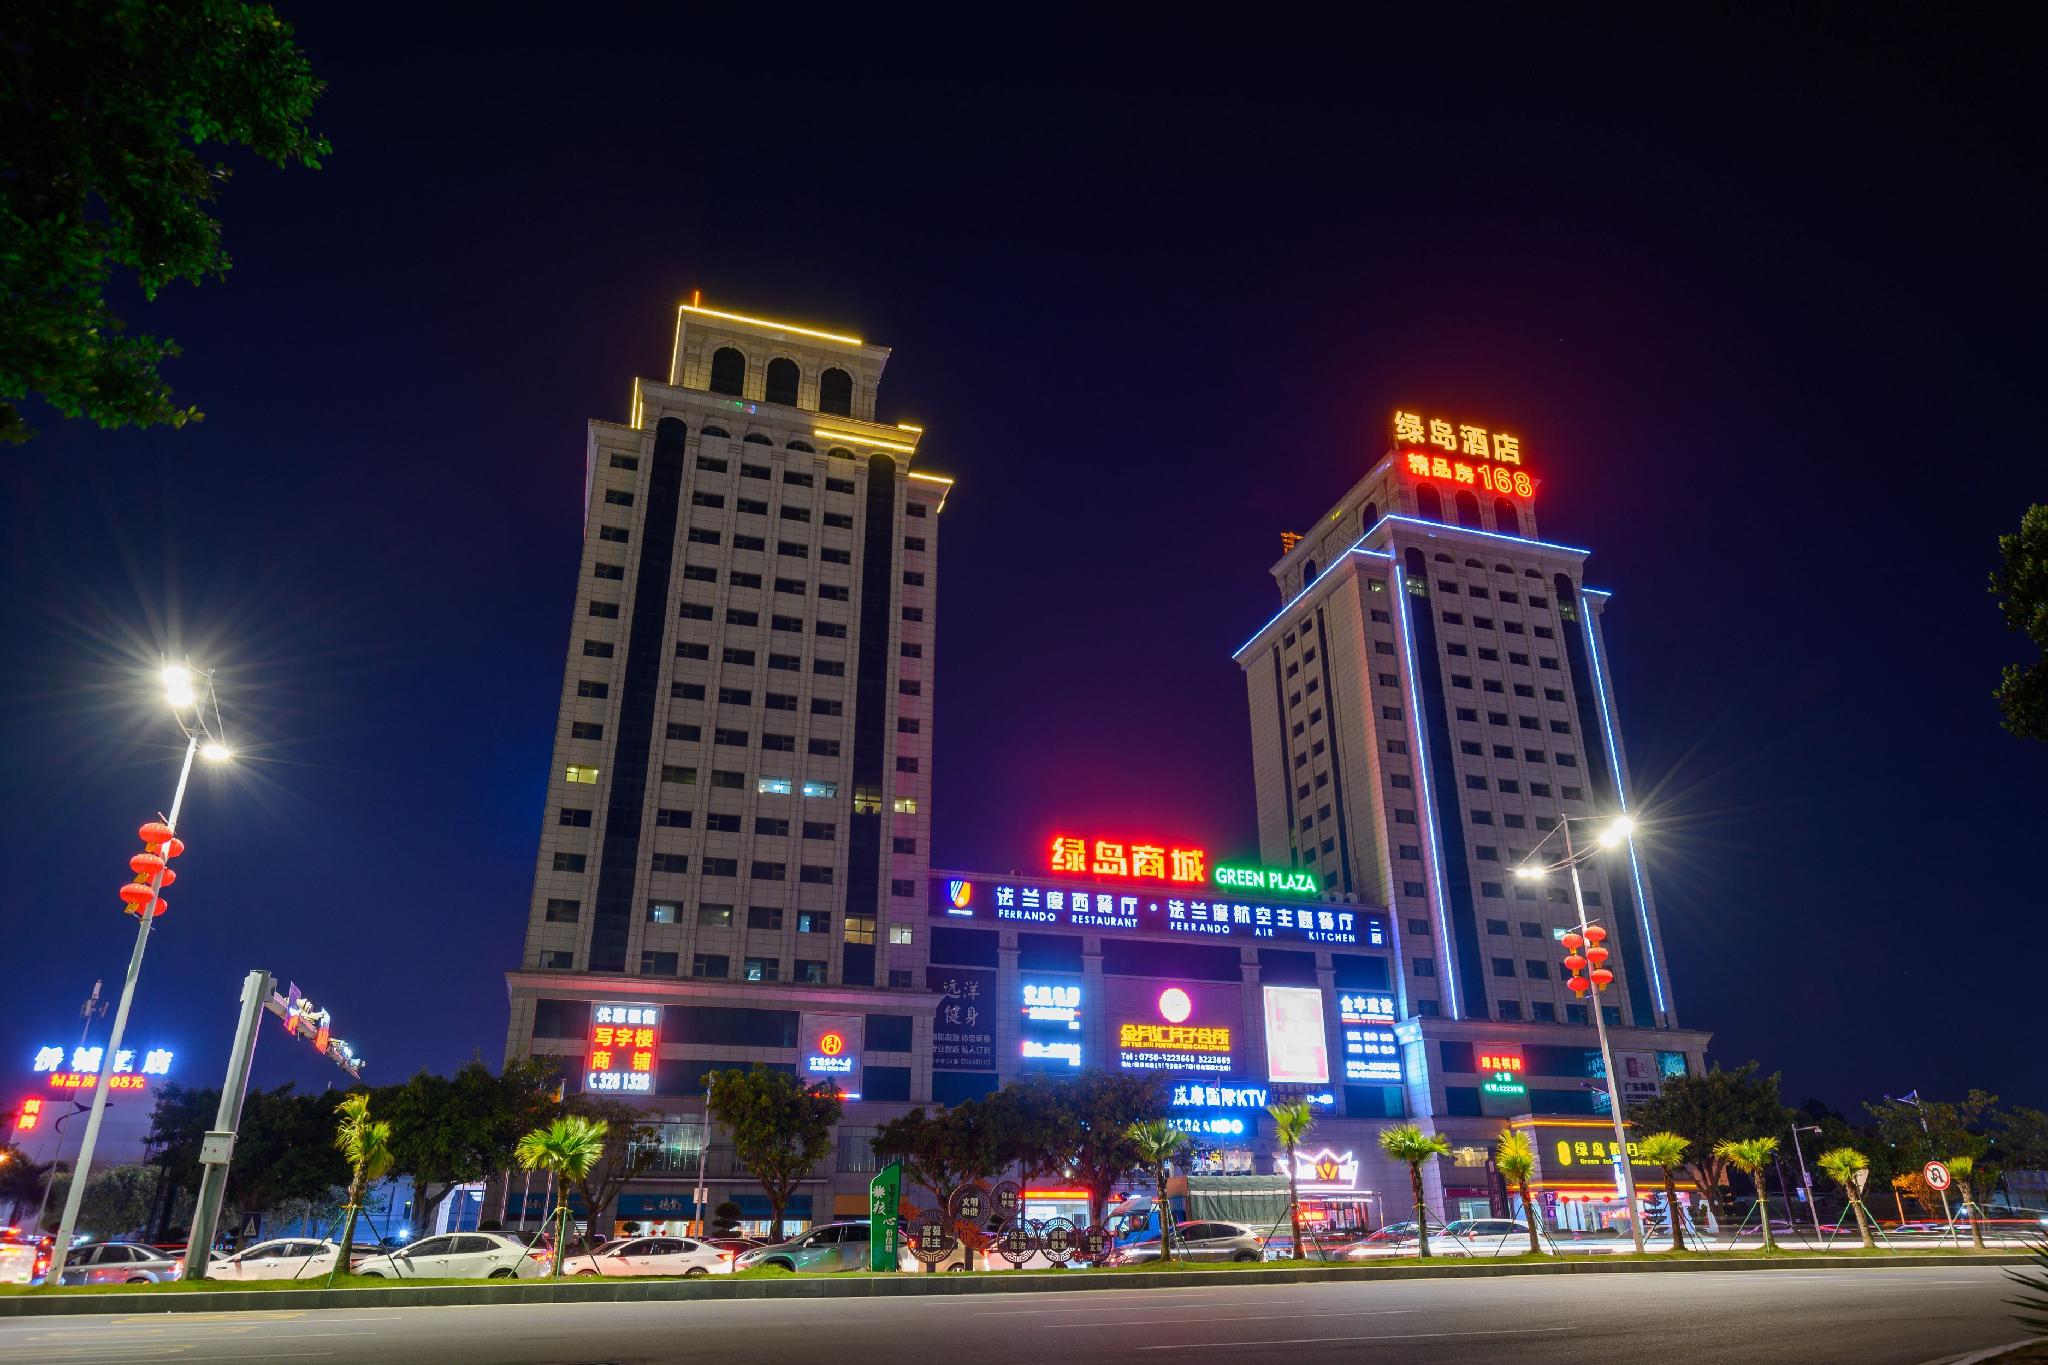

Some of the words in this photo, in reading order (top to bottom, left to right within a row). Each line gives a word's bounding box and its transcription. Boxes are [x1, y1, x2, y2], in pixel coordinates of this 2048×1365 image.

[1395, 410, 1521, 465] 绿岛酒店
[1051, 837, 1204, 883] 绿岛商城
[1215, 867, 1265, 887] GREEN
[1270, 872, 1317, 892] PLAZA
[998, 909, 1056, 922] FERRANDO
[1072, 915, 1137, 928] RESTAURANT
[1170, 922, 1230, 934] FERRANDO
[1255, 928, 1274, 938] AIR
[1308, 931, 1356, 943] KITCHEN
[943, 979, 980, 1000] 远洋
[944, 1004, 978, 1026] 健身
[594, 1027, 654, 1048] 写字楼
[50, 1073, 145, 1088] 精品房08元
[962, 1197, 979, 1207] 文明
[962, 1208, 979, 1217] 和谐
[922, 1226, 941, 1235] 富强
[1010, 1231, 1027, 1240] 公正
[922, 1238, 941, 1248] 民主
[1010, 1241, 1027, 1249] 法治
